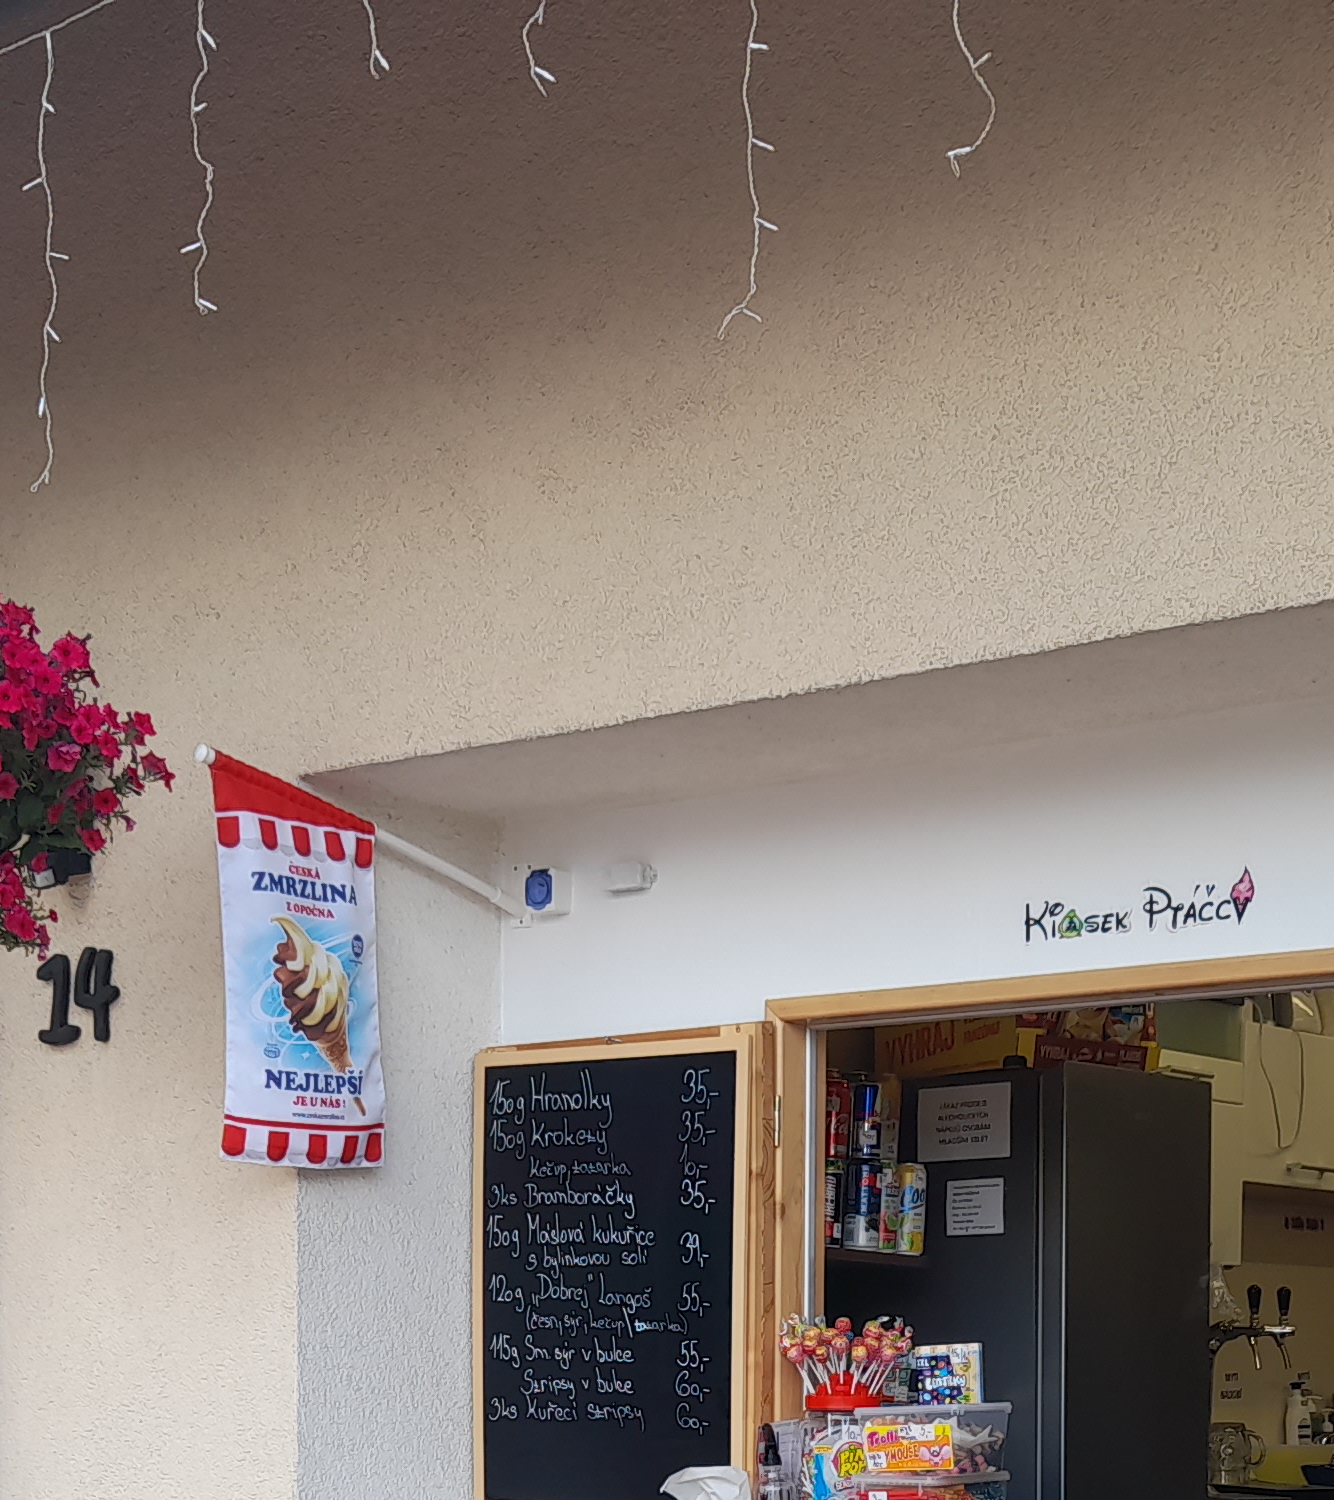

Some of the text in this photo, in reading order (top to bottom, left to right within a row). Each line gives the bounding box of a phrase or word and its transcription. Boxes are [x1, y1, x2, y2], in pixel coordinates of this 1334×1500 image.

[251, 871, 357, 906] ZMRZLINA
[36, 946, 120, 1045] 14
[264, 1069, 364, 1095] NEJLEPŠÍ
[530, 1067, 613, 1128] Hranolky
[292, 1096, 308, 1106] JE
[310, 1097, 318, 1107] U
[530, 1117, 608, 1155] Krokety
[487, 1183, 518, 1208] 3ks
[523, 1178, 635, 1220] Bramboráčky
[526, 1212, 585, 1246] Máslová
[590, 1213, 656, 1247] kukuřice
[525, 1252, 538, 1271] s
[543, 1246, 610, 1279] bylinkovou
[598, 1272, 653, 1314] Langoš
[581, 1348, 591, 1361] v
[593, 1335, 635, 1363] bulce
[520, 1368, 576, 1399] Stripsy
[581, 1379, 590, 1390] v
[595, 1367, 635, 1394] bulce
[488, 1397, 518, 1421] 3ks
[587, 1403, 646, 1433] stripsy
